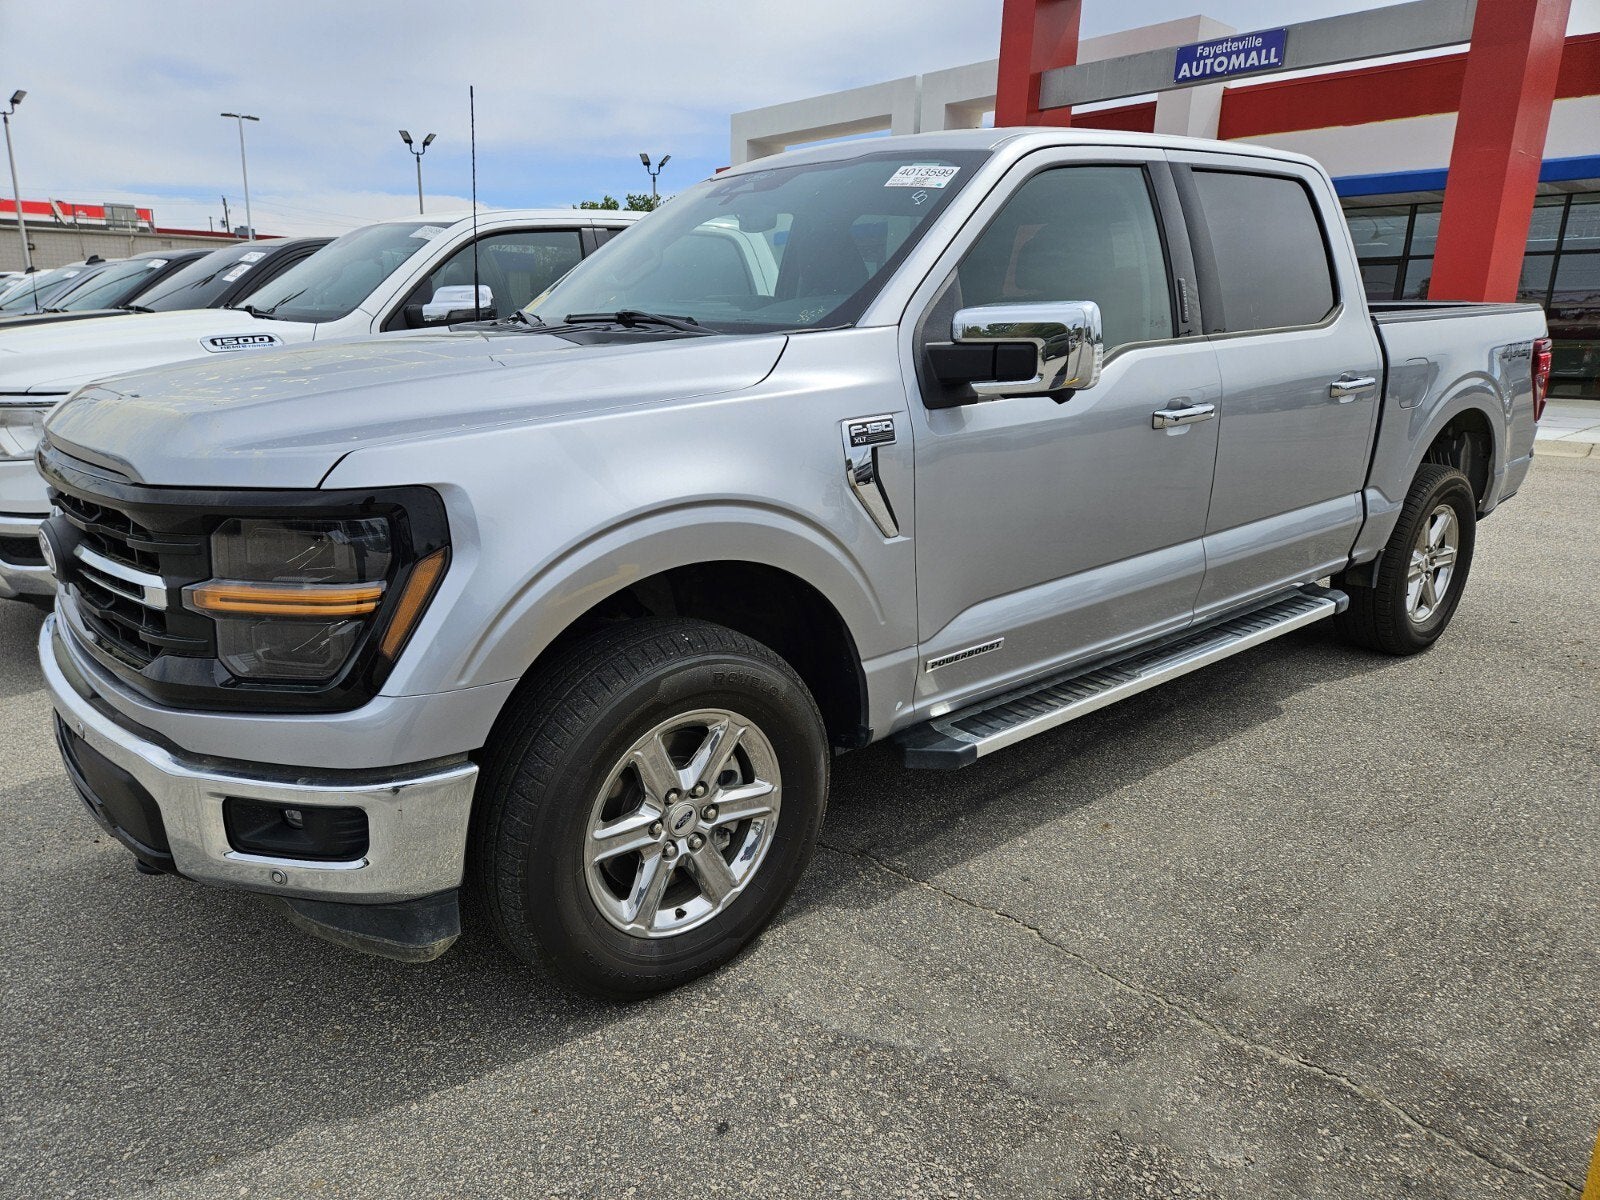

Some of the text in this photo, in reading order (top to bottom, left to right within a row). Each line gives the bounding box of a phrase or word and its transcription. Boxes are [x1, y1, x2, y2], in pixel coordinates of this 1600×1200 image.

[1196, 36, 1263, 58] Fayetteville
[1178, 47, 1280, 79] AUTOMALL
[899, 168, 955, 178] 4013599
[213, 336, 270, 346] 1500
[850, 420, 894, 437] F-150
[853, 436, 867, 444] XLT
[930, 640, 1002, 669] POWERBOOST
